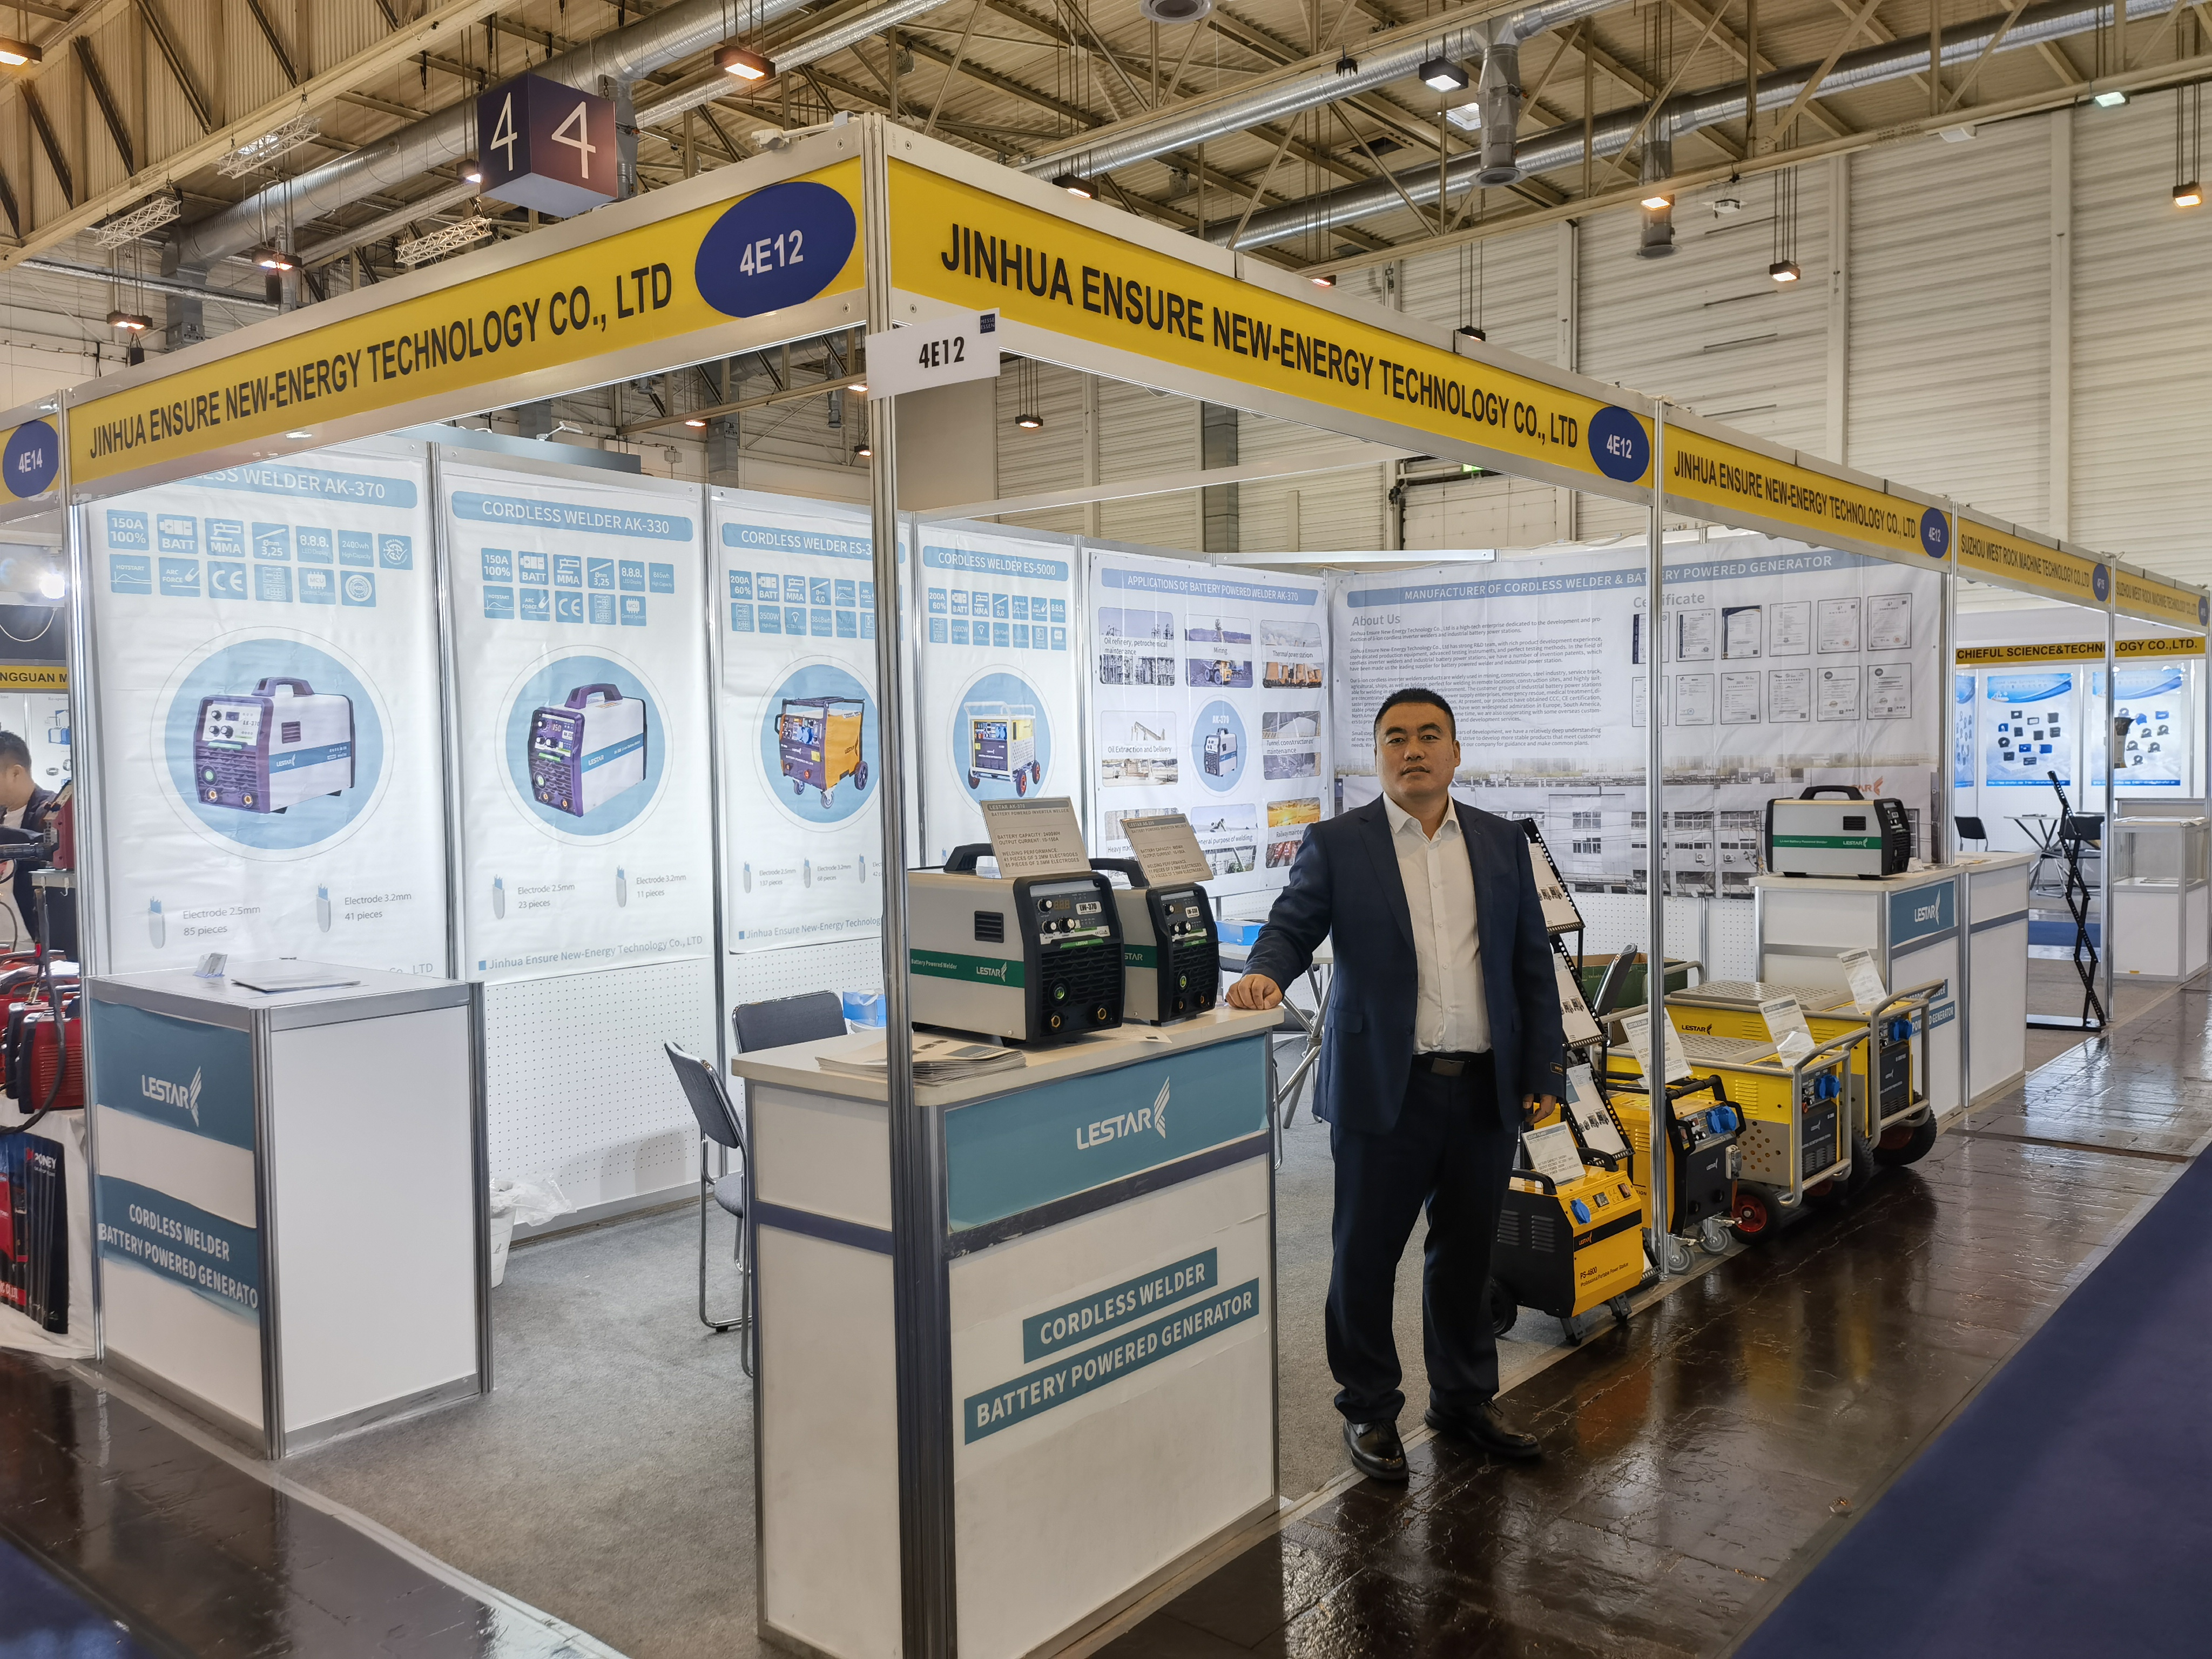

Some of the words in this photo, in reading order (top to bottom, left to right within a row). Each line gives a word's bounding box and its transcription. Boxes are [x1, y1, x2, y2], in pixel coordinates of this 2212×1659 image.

[490, 92, 517, 171] 4
[551, 101, 596, 179] 4
[739, 230, 804, 276] 4E12
[941, 223, 1073, 305] JINHUA
[1082, 265, 1204, 342] ENSURE
[1213, 306, 1373, 389] NEW-ENERGY
[1379, 359, 1509, 428] TECHNOLOGY
[1514, 401, 1545, 445] CO.,
[1550, 412, 1577, 448] LTD
[90, 414, 146, 458] JINHUA
[150, 390, 220, 442] ENSURE
[226, 349, 361, 421] NEW-ENERGY
[367, 298, 540, 382] TECHNOLOGY
[549, 285, 605, 335] CO.,
[617, 262, 671, 319] LTD
[919, 335, 965, 369] 4E12
[1607, 434, 1632, 460] 4E12
[18, 448, 42, 474] 4E14
[242, 468, 320, 491] WELDER
[325, 478, 385, 498] AK-370
[1674, 450, 1717, 486] JINHUA
[1719, 462, 1762, 498] ENSURE
[1765, 476, 1827, 515] NEW-ENERGY
[1829, 496, 1884, 530] TECHNOLOGY
[1887, 511, 1900, 536] CO.,
[1903, 516, 1915, 538] LTD
[111, 517, 144, 530] 150A
[482, 501, 561, 522] CORDLESS
[564, 509, 621, 529] WELDER
[624, 517, 669, 534] AK-330
[110, 531, 146, 543] 100%
[741, 530, 801, 547] CORDLESS
[803, 537, 847, 552] WELDER
[1928, 527, 1941, 543] 4E12
[161, 538, 195, 550] BATT
[211, 542, 241, 554] MMA
[342, 541, 369, 550] 2400wh
[1961, 534, 1985, 558] SUZHOU
[1986, 542, 2002, 563] WEST
[2003, 547, 2018, 567] ROCK
[485, 554, 509, 564] 150A
[938, 552, 986, 568] CORDLESS
[987, 557, 1021, 571] WELDER
[1023, 562, 1055, 575] ES-5000
[484, 566, 510, 576] 100%
[522, 571, 546, 582] BATT
[1405, 585, 1486, 600] MANUFACTURER
[1488, 584, 1501, 594] OF
[1505, 579, 1562, 592] CORDLESS
[1566, 575, 1611, 589] WELDER
[1615, 574, 1623, 584] &
[1627, 569, 1680, 584] BATERY
[1683, 564, 1746, 578] POWERED
[1750, 555, 1832, 573] GENERATOR
[557, 575, 579, 585] MMA
[1128, 575, 1178, 590] APPLICATIONS
[1179, 582, 1188, 591] OF
[1190, 582, 1220, 594] BATTERY
[1222, 585, 1251, 597] POWERED
[1252, 588, 1276, 599] WELDER
[1277, 591, 1298, 602] AK-370
[1633, 594, 1703, 609] Ceificate
[1352, 613, 1384, 626] About
[1387, 613, 1400, 624] Us
[1112, 639, 1133, 648] refinery,
[1135, 640, 1168, 649] petrochemical
[1213, 646, 1228, 655] Mining
[1957, 649, 2004, 659] CHIEFUL
[2006, 639, 2144, 657] SCIENCE&TECHNOGY
[2148, 638, 2197, 650] CO.,LTD.
[1154, 745, 1172, 754] Delivery
[345, 894, 382, 905] Electrode
[385, 893, 411, 901] 3.2mm
[1080, 903, 1097, 911] LW-370
[183, 908, 227, 919] Electrode
[229, 906, 260, 915] 2.5mm
[357, 911, 382, 921] pieces
[1914, 905, 1936, 922] LESTAR
[183, 927, 195, 935] 85
[198, 926, 227, 936] pieces
[489, 957, 523, 969] Jinhua
[525, 954, 558, 965] Ensure
[561, 947, 615, 960] New-Energy
[617, 941, 667, 953] Technology
[669, 939, 685, 947] Co.,
[687, 935, 702, 945] LTD
[911, 958, 926, 967] Battery
[926, 960, 943, 968] Powered
[943, 962, 957, 970] Welder
[976, 966, 1001, 977] LESTAR
[1932, 1006, 1954, 1023] GENERATOR
[1682, 1024, 1706, 1033] LESTAR
[141, 1074, 189, 1108] LESTAR
[1076, 1107, 1151, 1150] LESTAR
[129, 1203, 182, 1240] CORDLESS
[183, 1225, 229, 1261] WELDER
[97, 1223, 143, 1256] BATTERY
[145, 1241, 196, 1279] POWERED
[1041, 1290, 1136, 1344] CORDLESS
[1139, 1263, 1204, 1305] WELDER
[977, 1370, 1066, 1427] BATTERY
[1071, 1333, 1157, 1387] POWERED
[1162, 1291, 1251, 1346] GENERATOR
